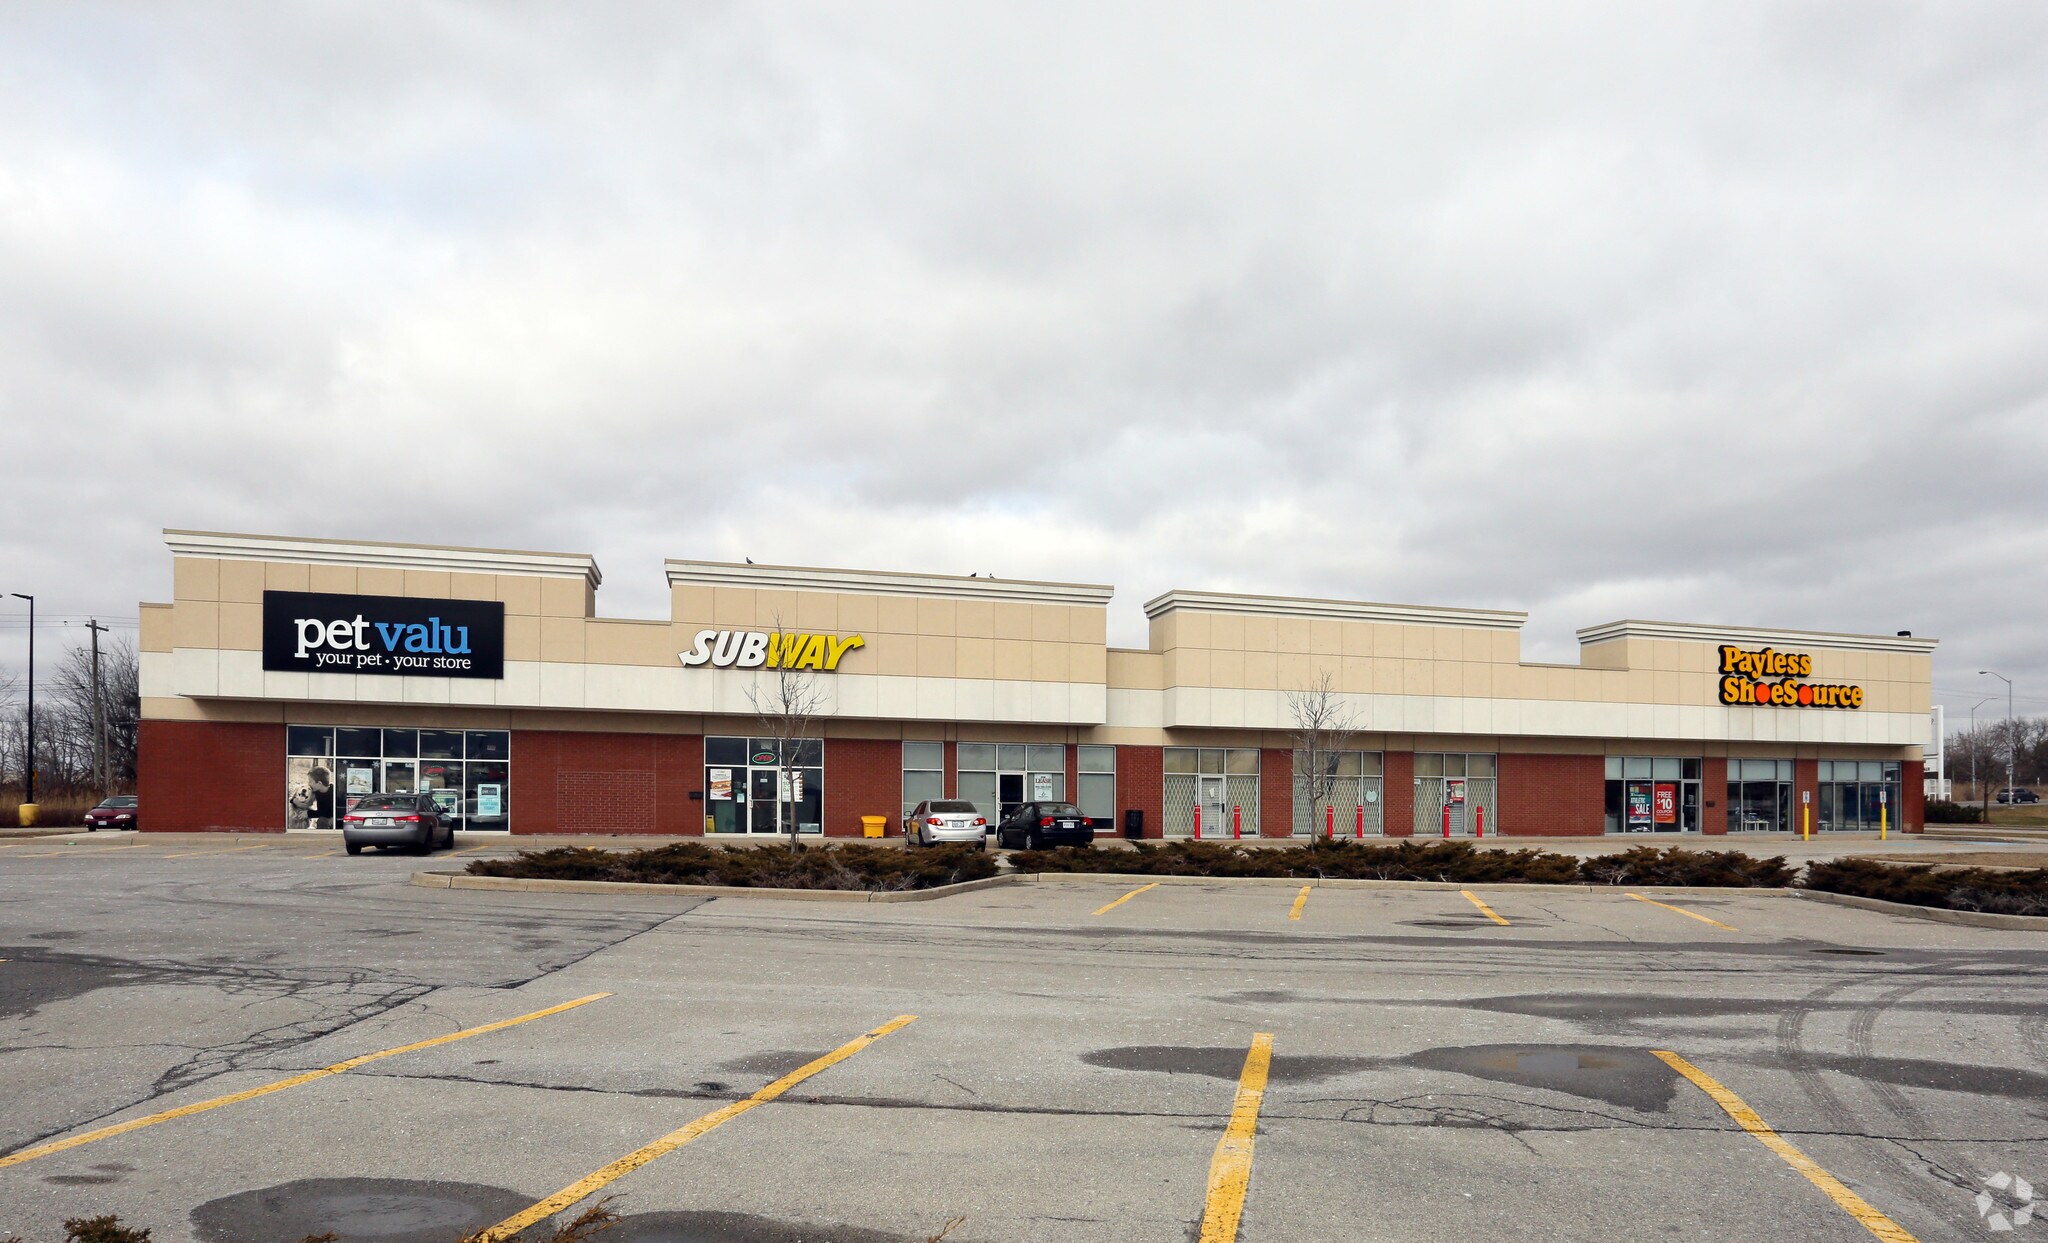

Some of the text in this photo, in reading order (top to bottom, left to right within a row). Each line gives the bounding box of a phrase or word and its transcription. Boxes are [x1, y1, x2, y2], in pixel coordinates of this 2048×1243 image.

[294, 614, 471, 658] pet valu
[678, 629, 865, 670] SUBWAY
[316, 652, 471, 670] your pet your store
[1719, 645, 1812, 680] Payless
[1719, 676, 1863, 709] ShoeSource
[1635, 804, 1650, 815] SALE
[1657, 798, 1672, 810] $10
